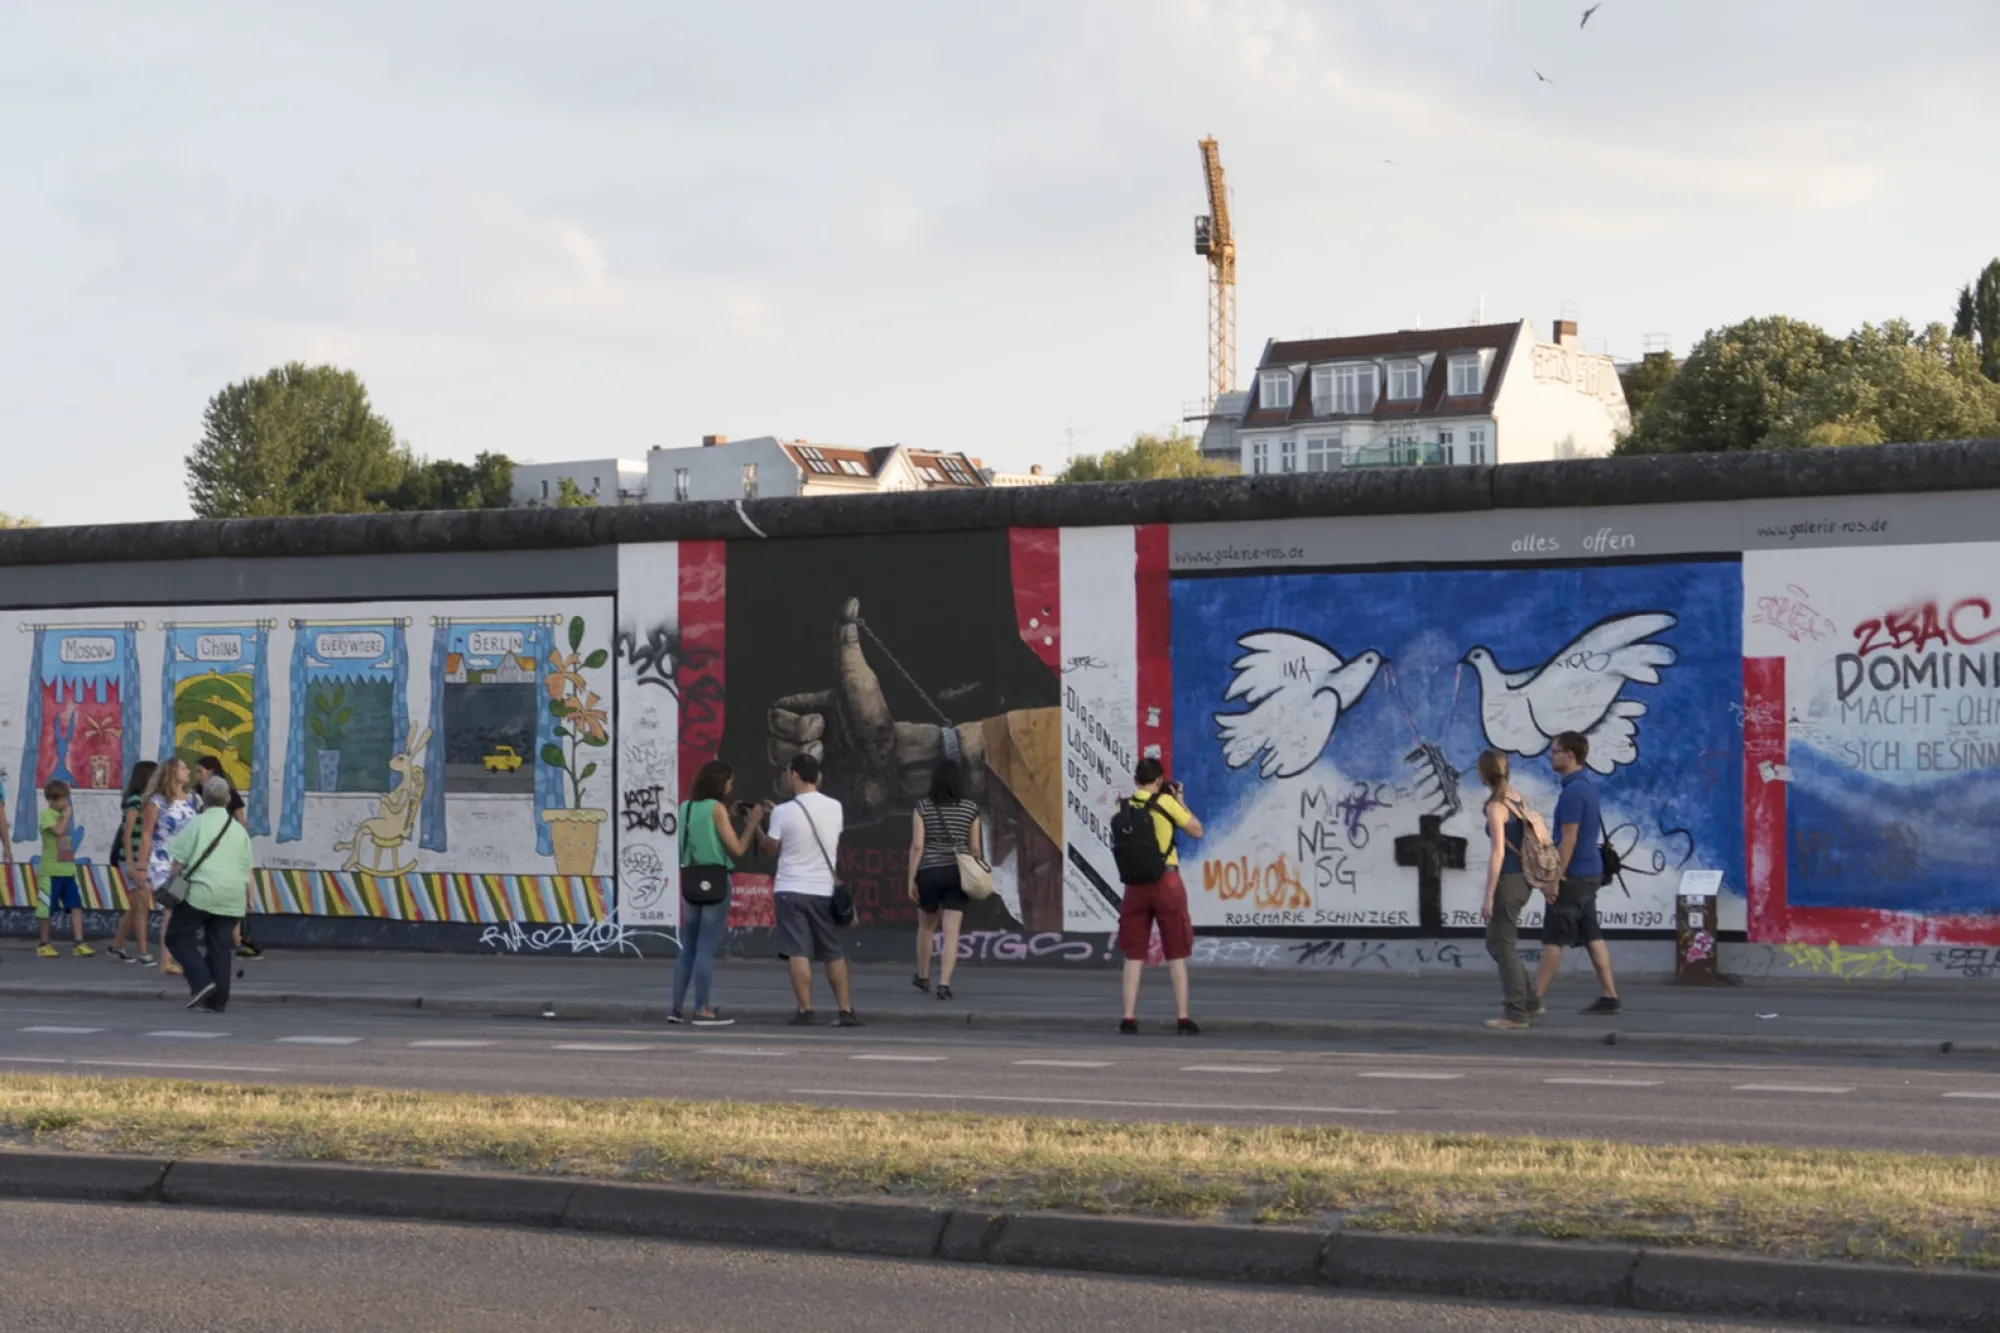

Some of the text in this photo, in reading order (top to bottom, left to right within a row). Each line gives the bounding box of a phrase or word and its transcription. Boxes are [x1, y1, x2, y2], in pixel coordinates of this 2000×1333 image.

[1511, 528, 1635, 552] alles offen
[1841, 693, 1937, 725] MACHT
[1066, 685, 1132, 775] DIAGONALE
[1067, 723, 1112, 786] LÖSUNG
[1842, 740, 1901, 771] SICH
[1067, 756, 1089, 793] DES
[1314, 909, 1410, 925] SCHINZLER
[1631, 910, 1663, 926] 1990
